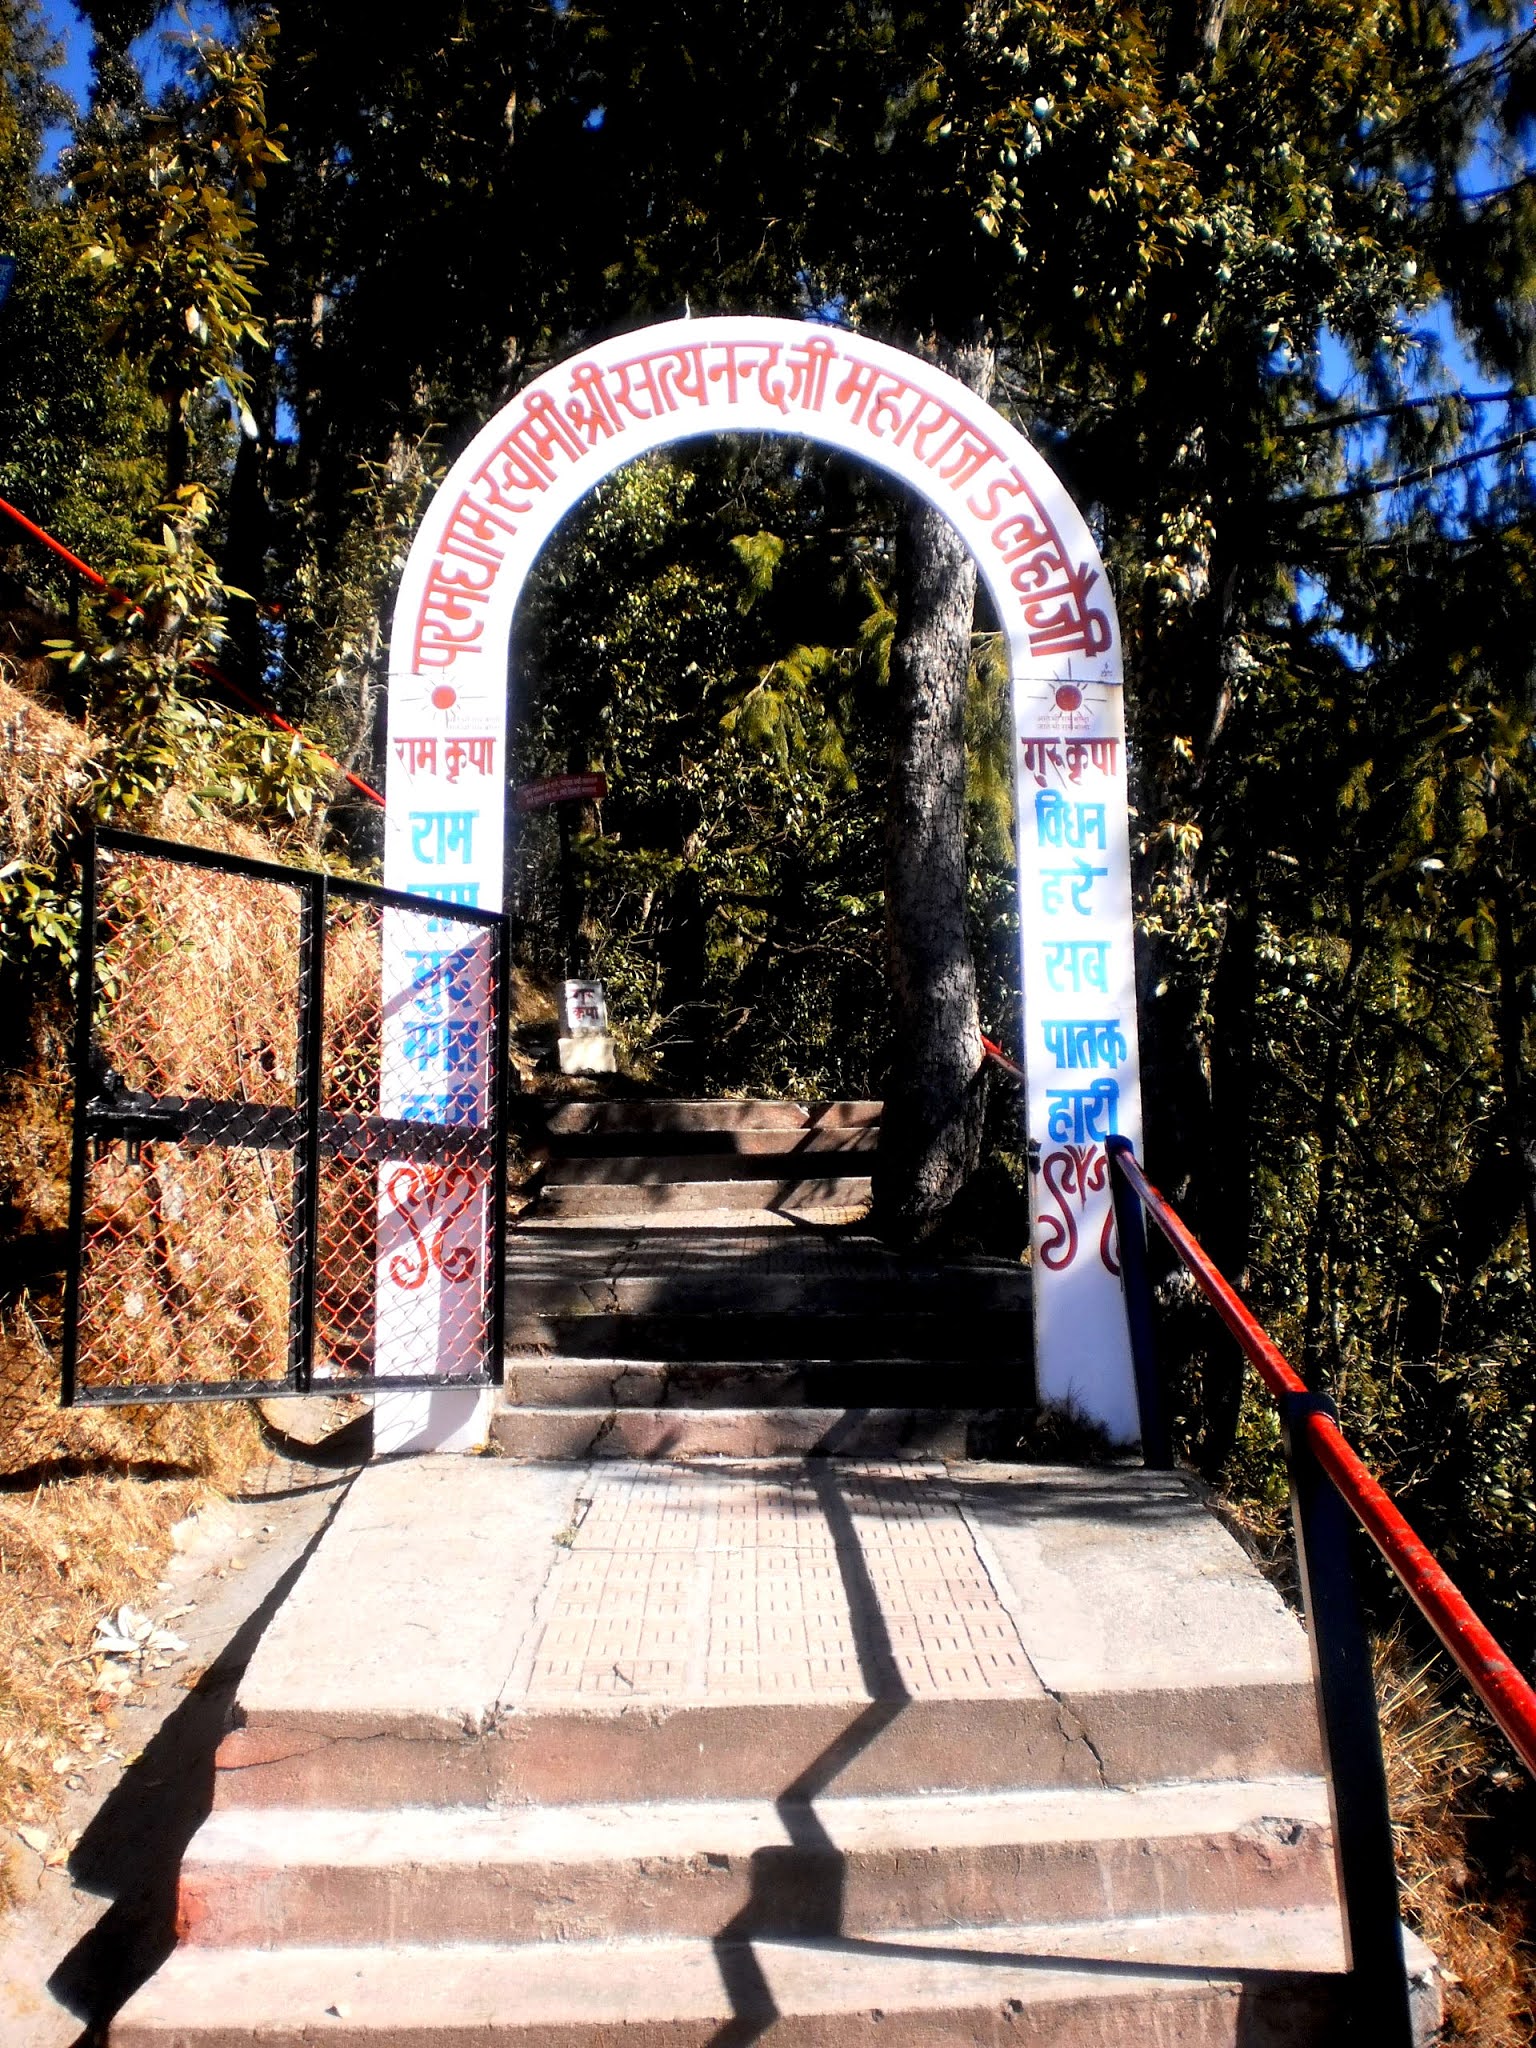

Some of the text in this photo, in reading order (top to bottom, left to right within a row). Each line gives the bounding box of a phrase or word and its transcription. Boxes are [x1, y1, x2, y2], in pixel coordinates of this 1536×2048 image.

[469, 389, 589, 513] स्वामी
[564, 360, 626, 445] श्री
[834, 354, 1008, 491] महाराज
[393, 736, 497, 785] राम कृपा
[1065, 736, 1120, 786] कृपा
[408, 809, 480, 865] राम
[1039, 855, 1108, 916] हरे
[1042, 939, 1112, 994] सब
[1041, 1019, 1128, 1070] पातक
[1046, 1077, 1120, 1144] हारी
